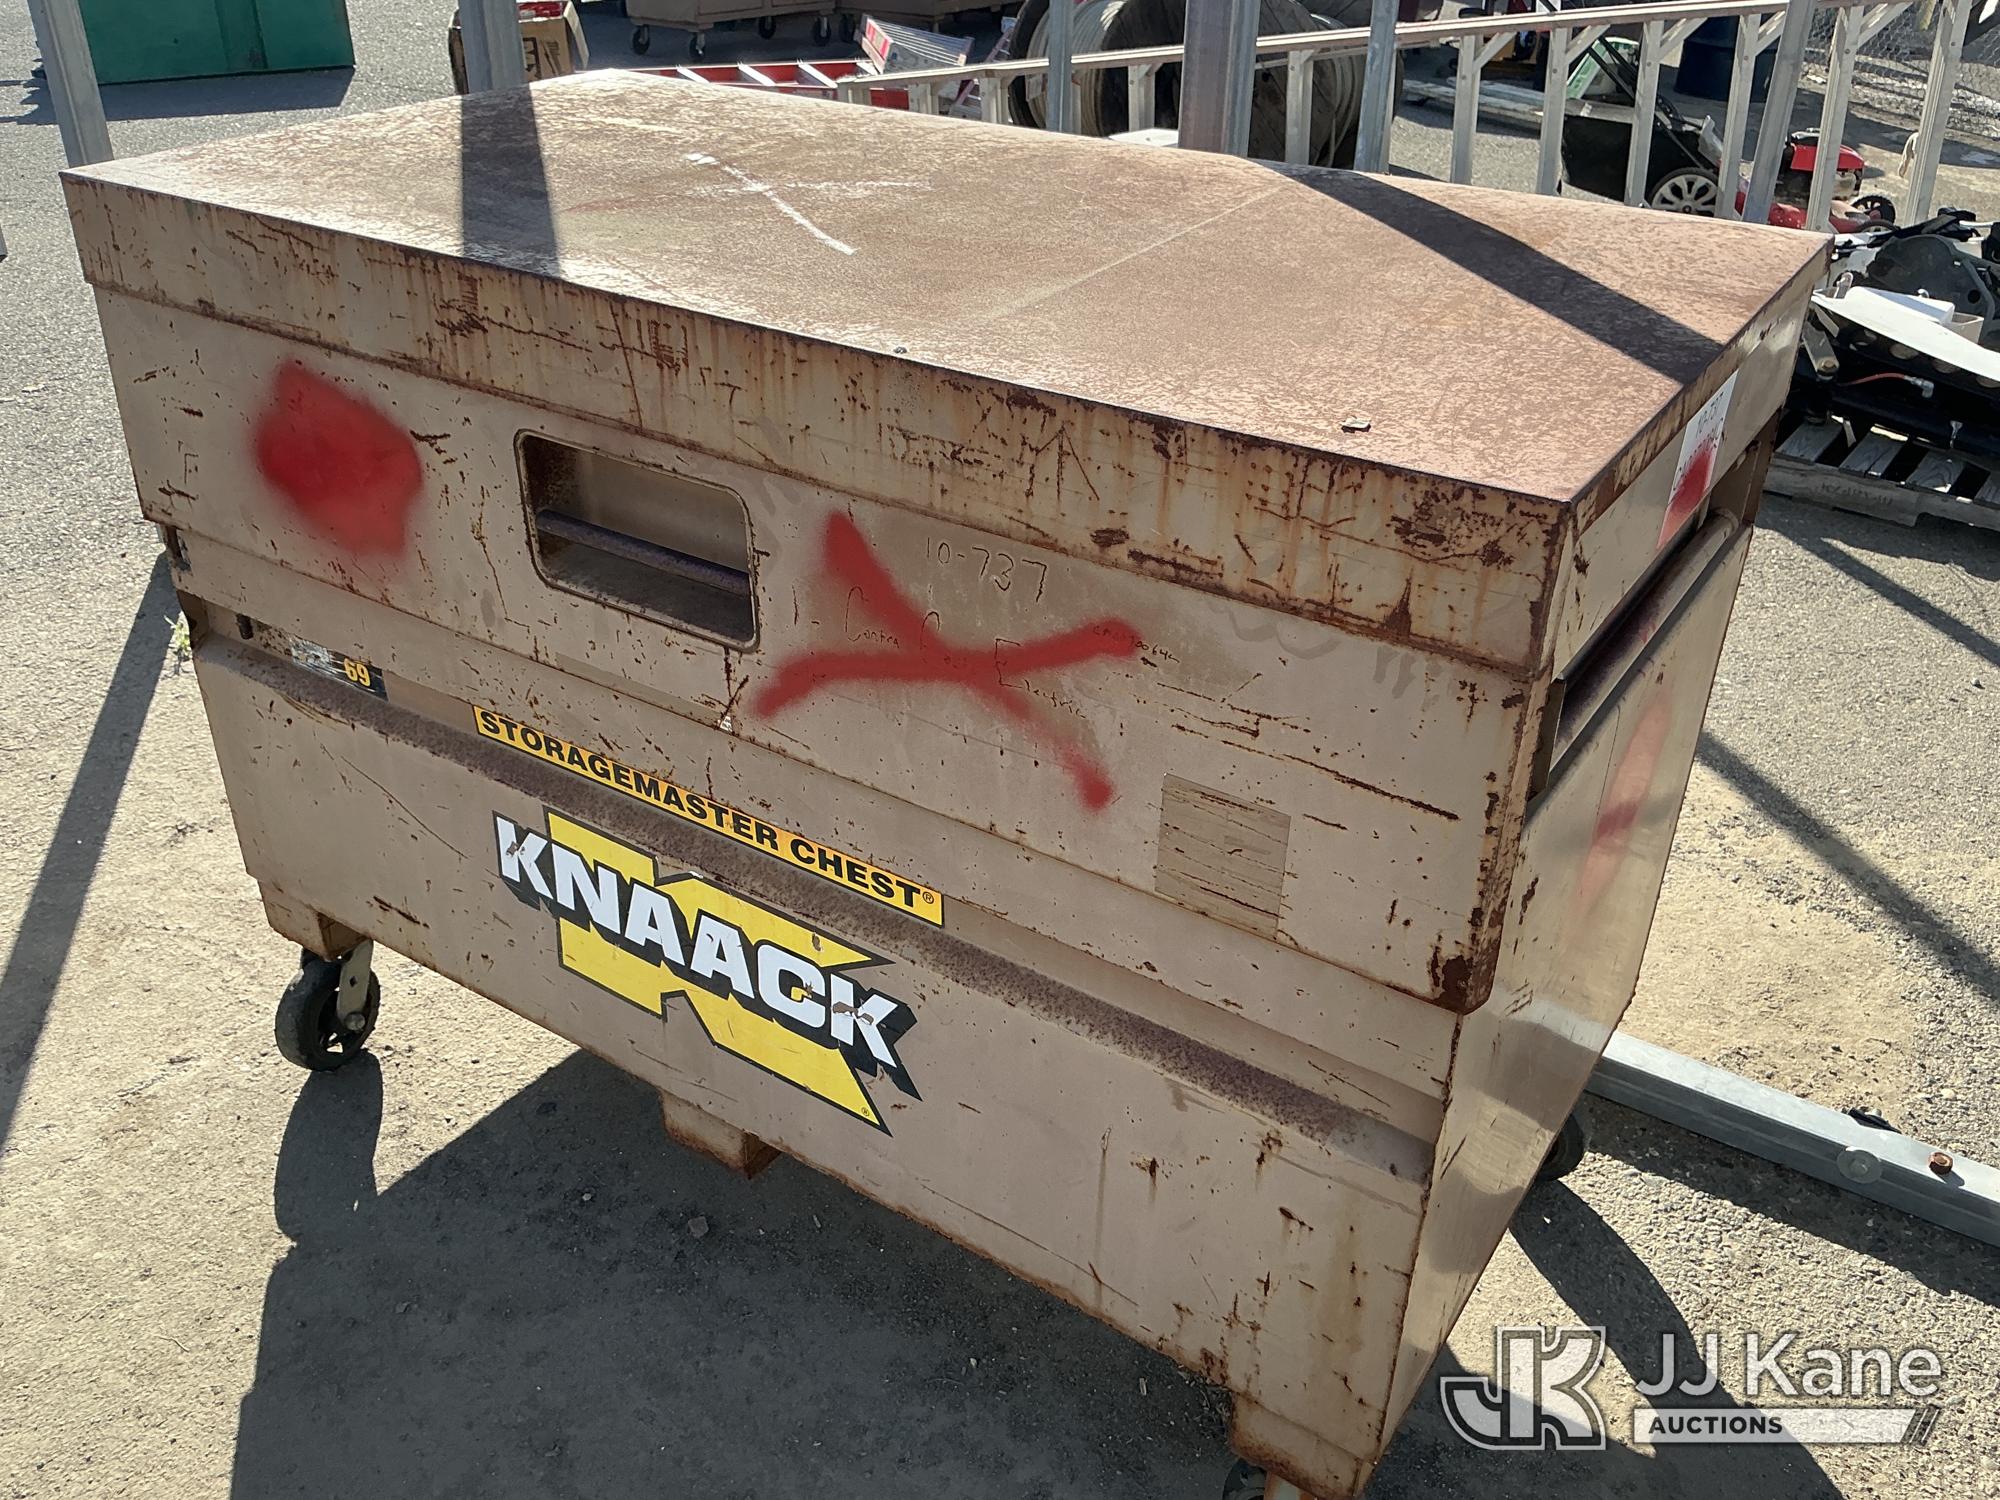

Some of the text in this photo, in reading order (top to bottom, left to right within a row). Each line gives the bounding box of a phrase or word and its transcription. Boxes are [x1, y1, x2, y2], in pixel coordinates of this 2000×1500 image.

[926, 536, 1047, 602] 10-737
[343, 657, 371, 687] 69
[479, 709, 780, 850] STORAGEMASTER
[494, 815, 899, 1069] KNAACK
